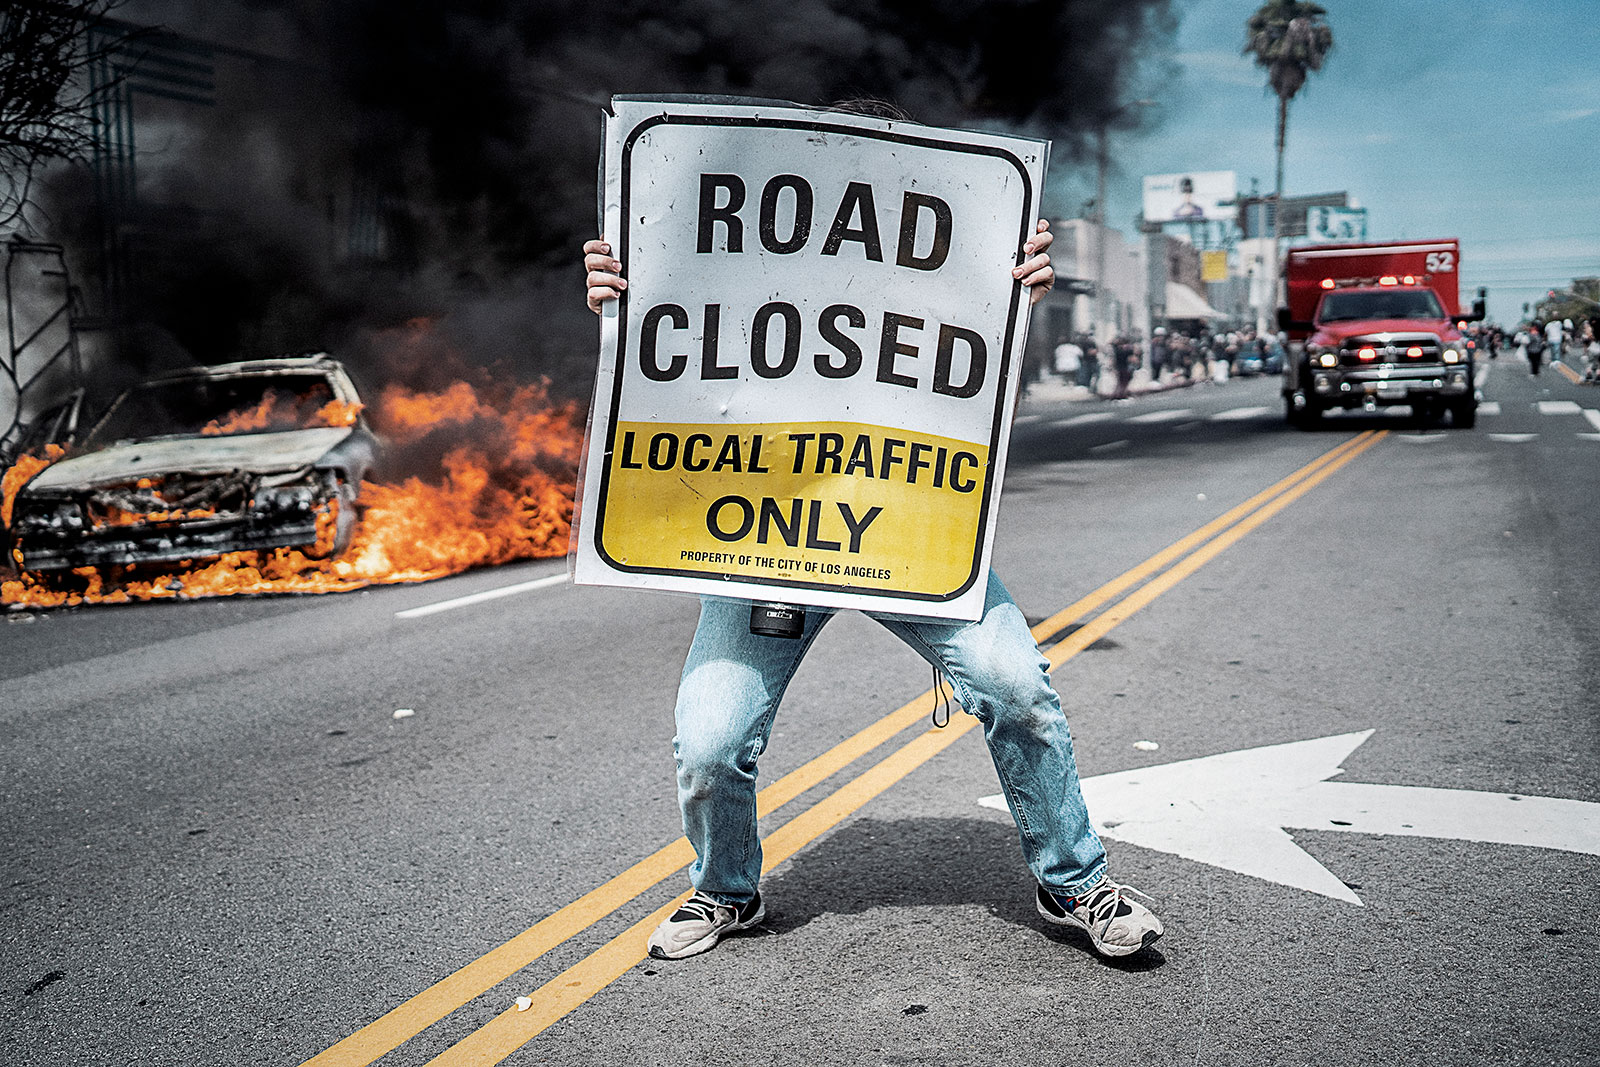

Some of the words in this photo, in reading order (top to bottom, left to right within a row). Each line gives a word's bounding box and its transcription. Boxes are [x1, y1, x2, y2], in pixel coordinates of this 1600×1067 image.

[696, 173, 953, 272] ROAD
[1425, 252, 1454, 272] 52
[639, 302, 988, 399] CLOSED
[620, 431, 770, 474] LOCAL
[788, 433, 979, 493] TRAFFIC
[706, 495, 884, 554] ONLY
[680, 550, 736, 564] PROPERTY
[738, 554, 752, 566] OF
[754, 556, 775, 569] THE
[777, 558, 802, 571] CITY
[804, 561, 818, 573] OF
[820, 563, 841, 575] LOS
[843, 565, 891, 580] ANGELES
